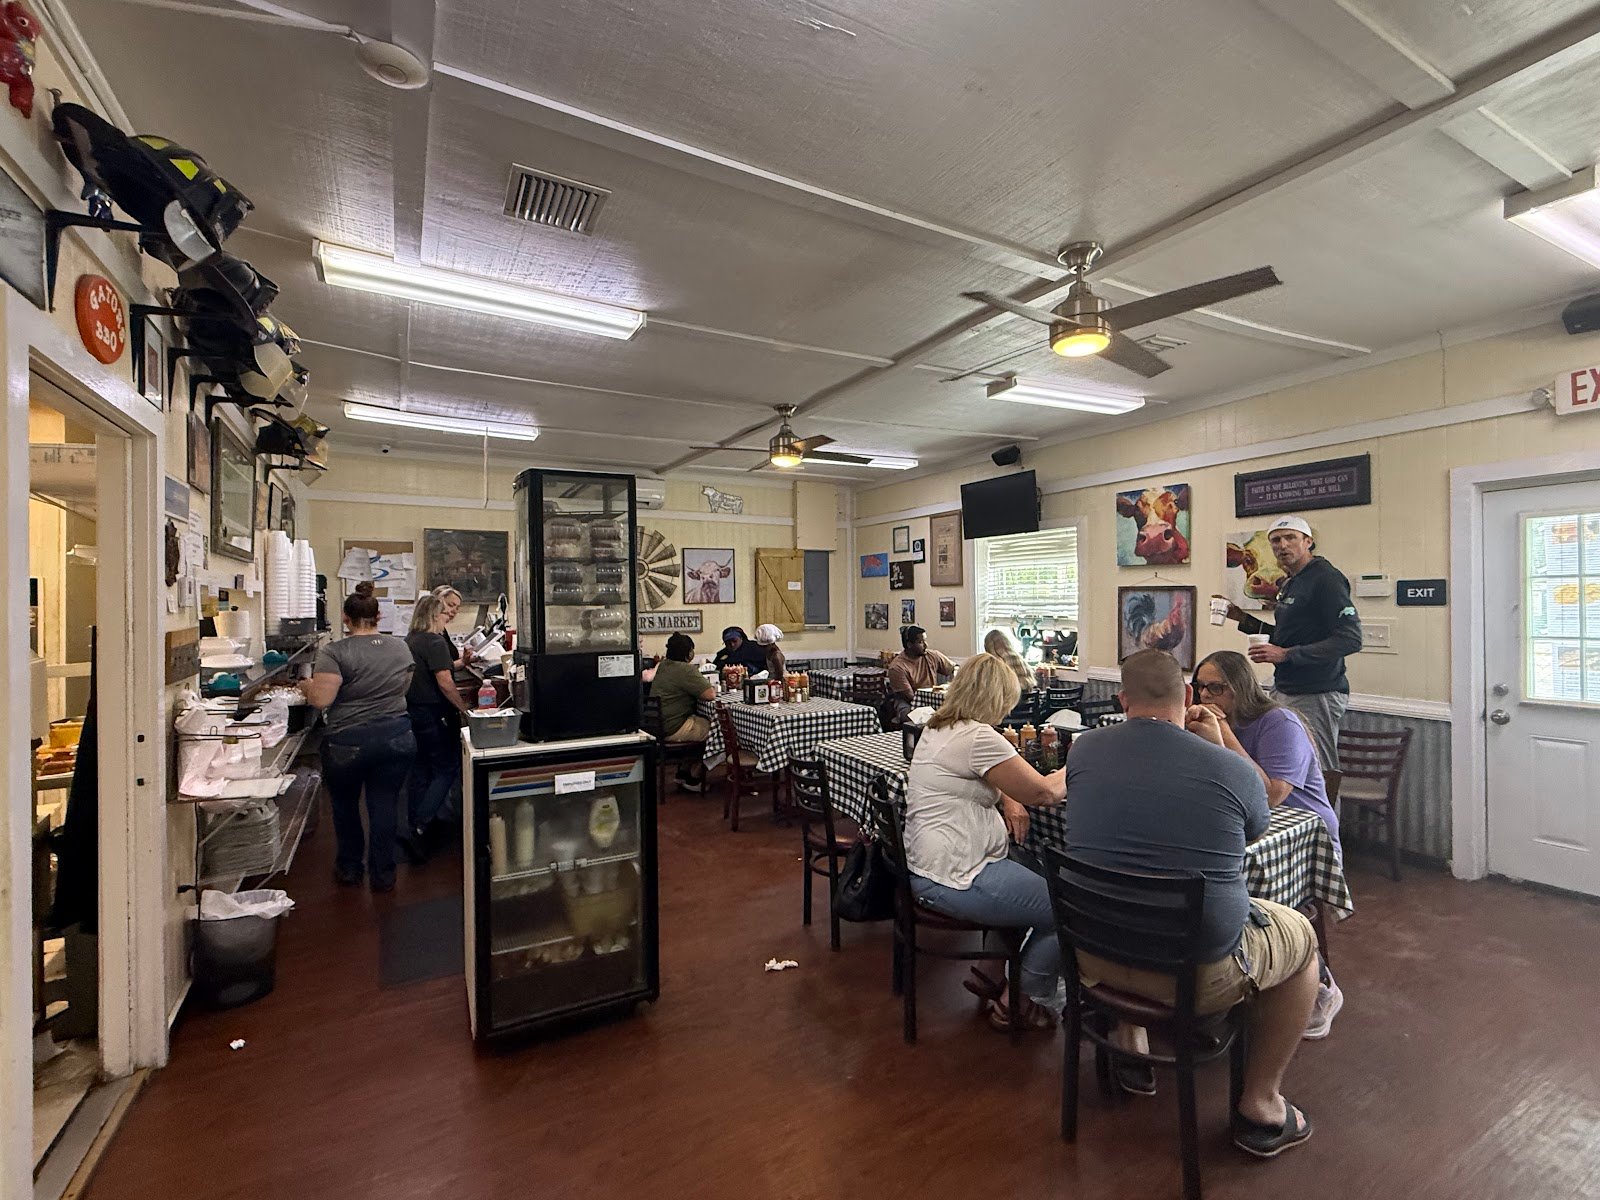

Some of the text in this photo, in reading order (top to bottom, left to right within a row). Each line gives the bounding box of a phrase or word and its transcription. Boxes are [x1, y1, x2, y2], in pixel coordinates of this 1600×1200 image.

[1272, 483, 1281, 491] NOT
[1283, 480, 1308, 489] BELIEVING
[1310, 478, 1323, 486] THAT
[1325, 476, 1336, 484] GOD
[1338, 474, 1348, 482] CAN
[1266, 493, 1272, 501] IT
[1279, 489, 1302, 498] KNOWING
[1303, 487, 1316, 496] THAT
[1318, 486, 1326, 494] HE
[1328, 484, 1341, 492] WILL
[1407, 588, 1435, 598] EXIT
[658, 615, 700, 629] MARKET
